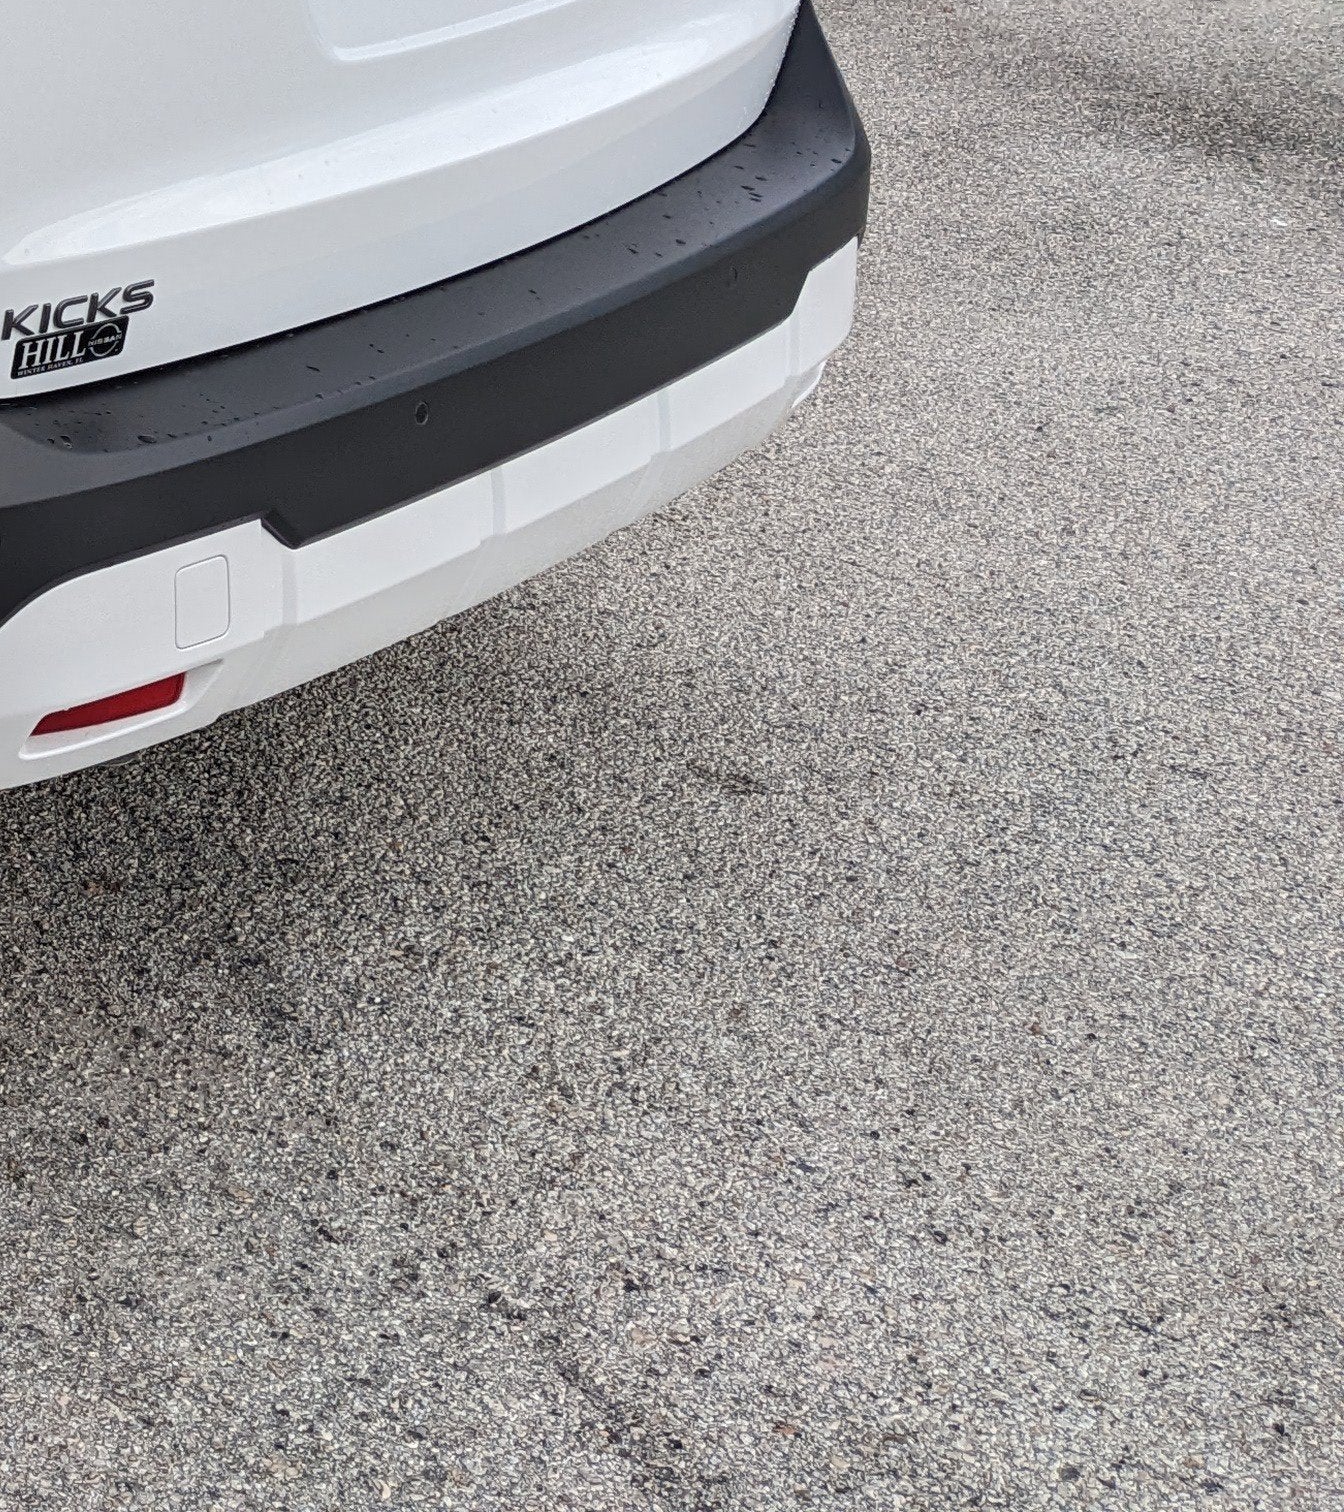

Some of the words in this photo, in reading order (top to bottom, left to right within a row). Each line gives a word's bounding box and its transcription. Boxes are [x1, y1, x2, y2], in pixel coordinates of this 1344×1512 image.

[0, 279, 155, 341] KICKS
[18, 330, 86, 370] HILL
[87, 333, 122, 347] NISSAN
